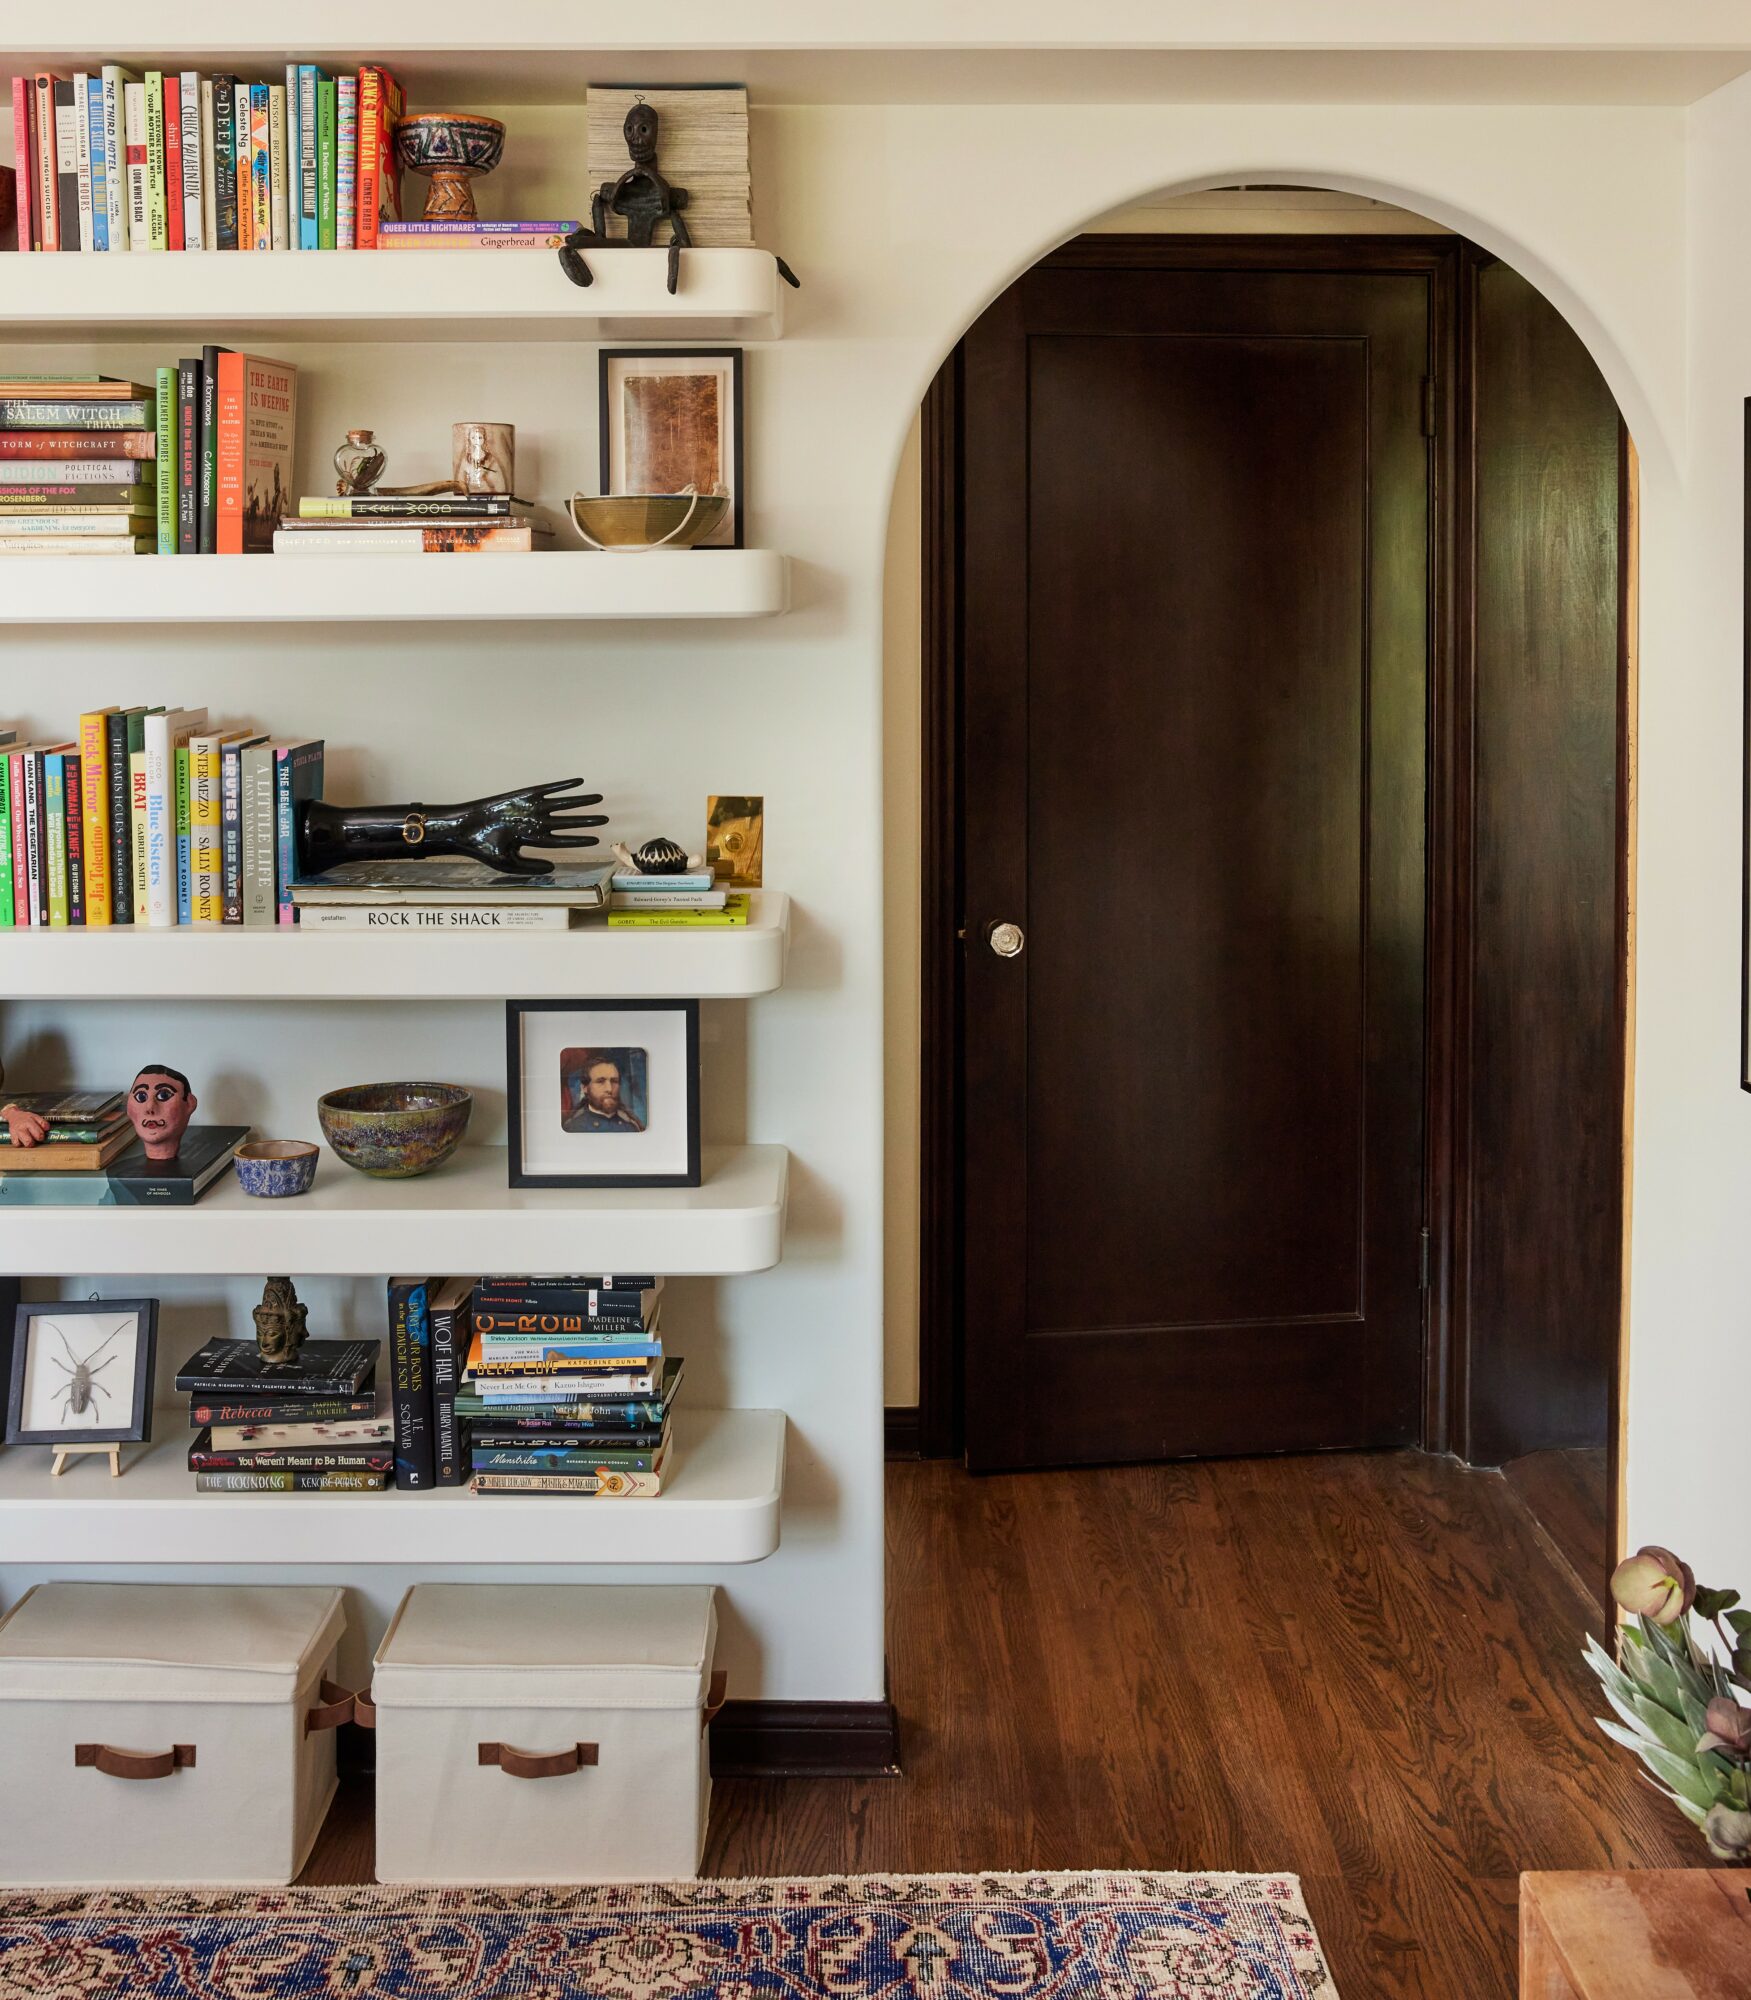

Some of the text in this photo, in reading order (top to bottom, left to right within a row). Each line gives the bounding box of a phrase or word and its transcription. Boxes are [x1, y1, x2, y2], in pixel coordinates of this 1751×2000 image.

[106, 80, 116, 172] THE THIRD HOTEL
[181, 105, 198, 137] CHUCK
[238, 97, 248, 148] Celeste Ng
[271, 94, 280, 189] POISON BREAKFAST
[302, 80, 315, 213] PREMONITIONS BUREAU SAM KNIGHT
[361, 73, 377, 230] HAWK MOUNTAIN CONNER HABIB
[79, 164, 89, 178] THE
[133, 168, 142, 184] LOOK
[168, 123, 179, 211] shrill lindy west
[183, 144, 200, 200] PALAHNIUK
[241, 170, 249, 187] Little
[80, 183, 90, 211] HOURS
[134, 186, 143, 205] WHO'S
[134, 206, 143, 223] BACK
[384, 224, 406, 233] QUEER
[408, 224, 430, 232] LITTLE
[431, 224, 476, 232] NIGHTMARES
[481, 237, 535, 249] Gingerbread
[160, 377, 168, 389] YOU
[250, 371, 288, 392] THE EARTH
[7, 408, 120, 420] SALEM WITCH
[160, 392, 168, 423] DREAMED
[205, 385, 213, 426] Tomorrows
[250, 392, 290, 413] IS WEEPING
[84, 420, 124, 429] TRIALS
[161, 424, 168, 433] OF
[161, 470, 171, 494] ÁLVARO
[161, 496, 169, 524] ENRIGUE
[406, 502, 451, 515] WOOD
[85, 722, 102, 812] Trick Mirror
[67, 780, 80, 858] WOMAN KNIFE
[133, 773, 147, 891] BRAT GABRIEL SMITH
[197, 744, 211, 921] INTERMEZZO SALLY ROONEY
[225, 754, 237, 898] BRUTES DIZZ TATE
[245, 775, 255, 877] HANYA YANAGIHARA
[257, 764, 271, 887] A LITTLE LIFE
[30, 827, 38, 880] VEGETARIAN
[149, 795, 164, 886] Blue Sisters
[89, 826, 105, 902] Jia Tolentino
[368, 912, 409, 925] ROCK
[417, 912, 444, 925] THE
[450, 912, 500, 925] SHACK
[475, 1315, 582, 1332] CIRCE
[588, 1316, 631, 1324] MADELINE
[477, 1362, 515, 1375] GEEK
[524, 1361, 559, 1375] LOVE
[434, 1316, 452, 1461] WOLF HALL HILARY MANTEL
[577, 1381, 605, 1390] Ishiguro
[220, 1405, 273, 1420] Rebecca
[506, 1404, 611, 1415] Didion Notes John
[400, 1403, 412, 1449] SCHWAB
[238, 1457, 253, 1466] You
[255, 1456, 285, 1466] Weren't
[287, 1456, 312, 1466] Meant
[315, 1457, 323, 1465] to
[324, 1456, 335, 1465] Be
[337, 1456, 366, 1465] Human
